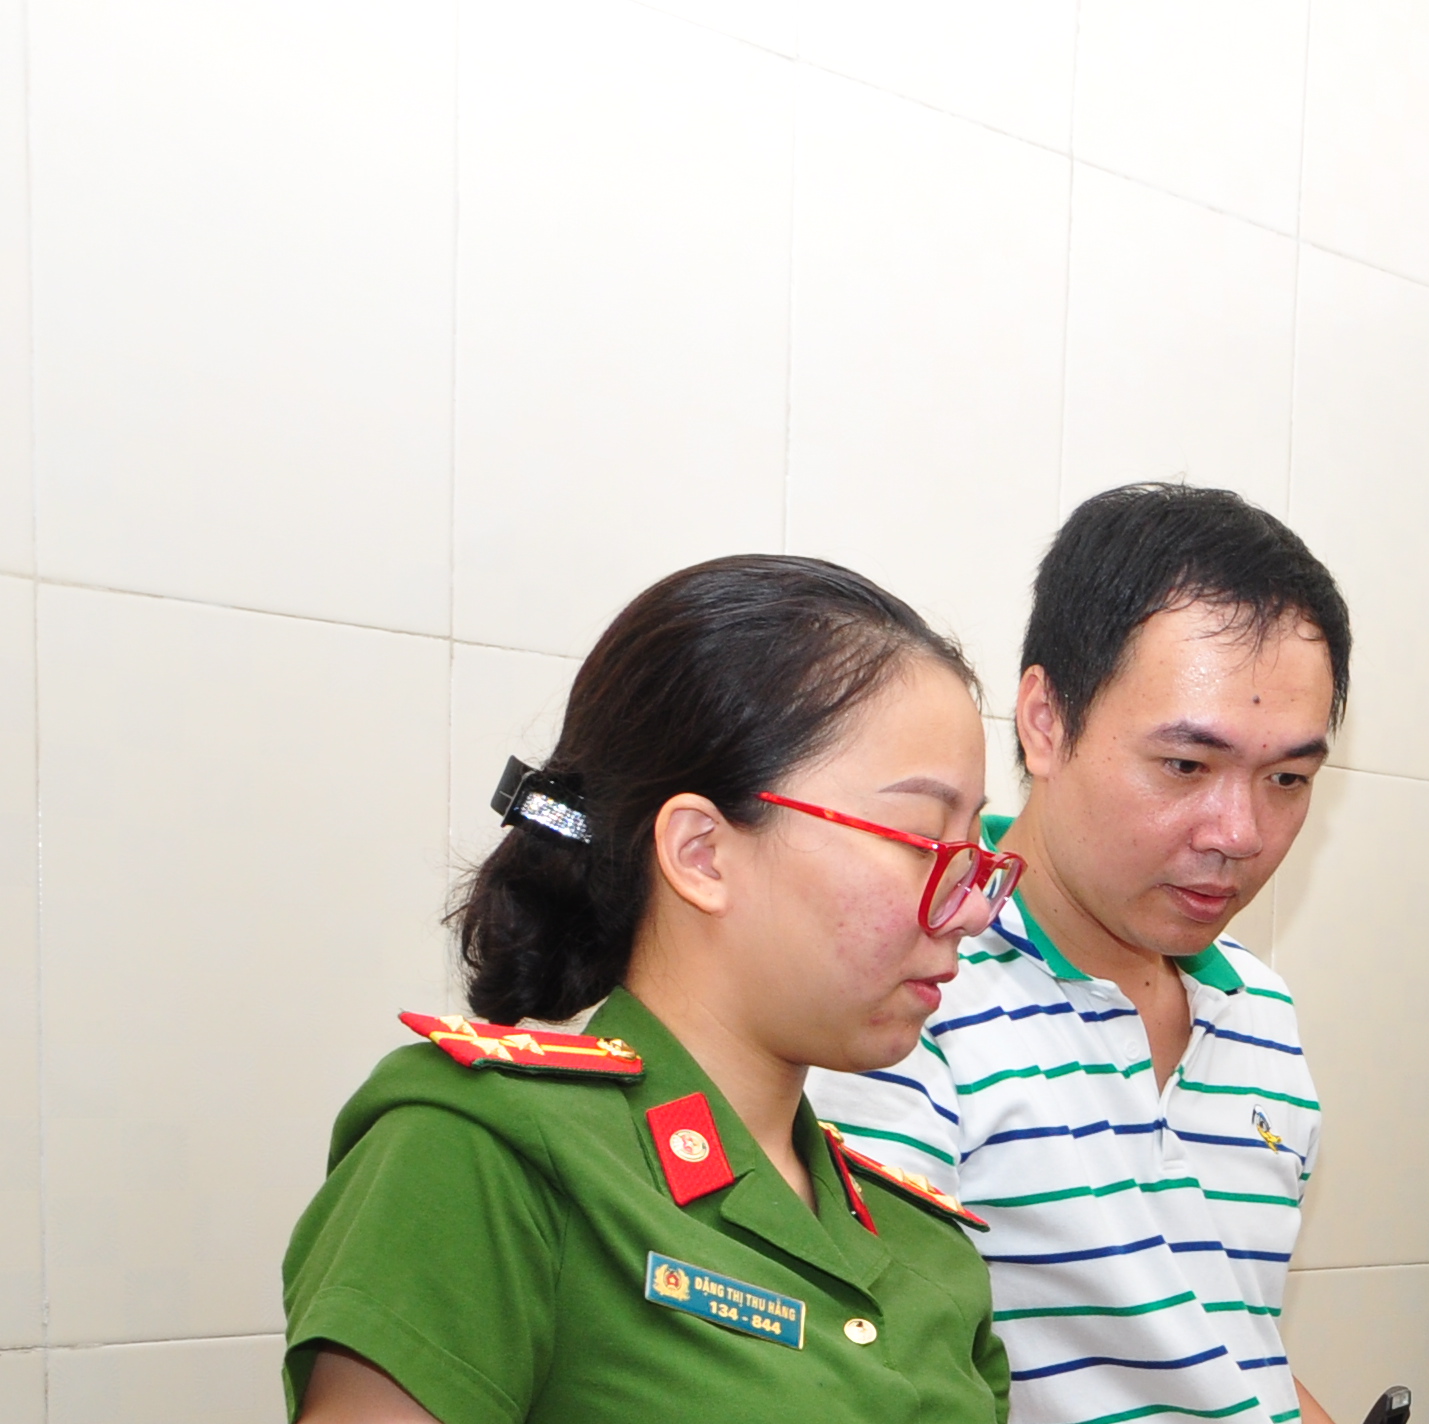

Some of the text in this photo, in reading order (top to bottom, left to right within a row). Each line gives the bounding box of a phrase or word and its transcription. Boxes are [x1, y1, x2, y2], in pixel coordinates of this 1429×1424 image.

[726, 1287, 744, 1307] THỊ
[745, 1293, 766, 1311] THU
[709, 1300, 739, 1321] 134
[751, 1314, 781, 1335] 844
